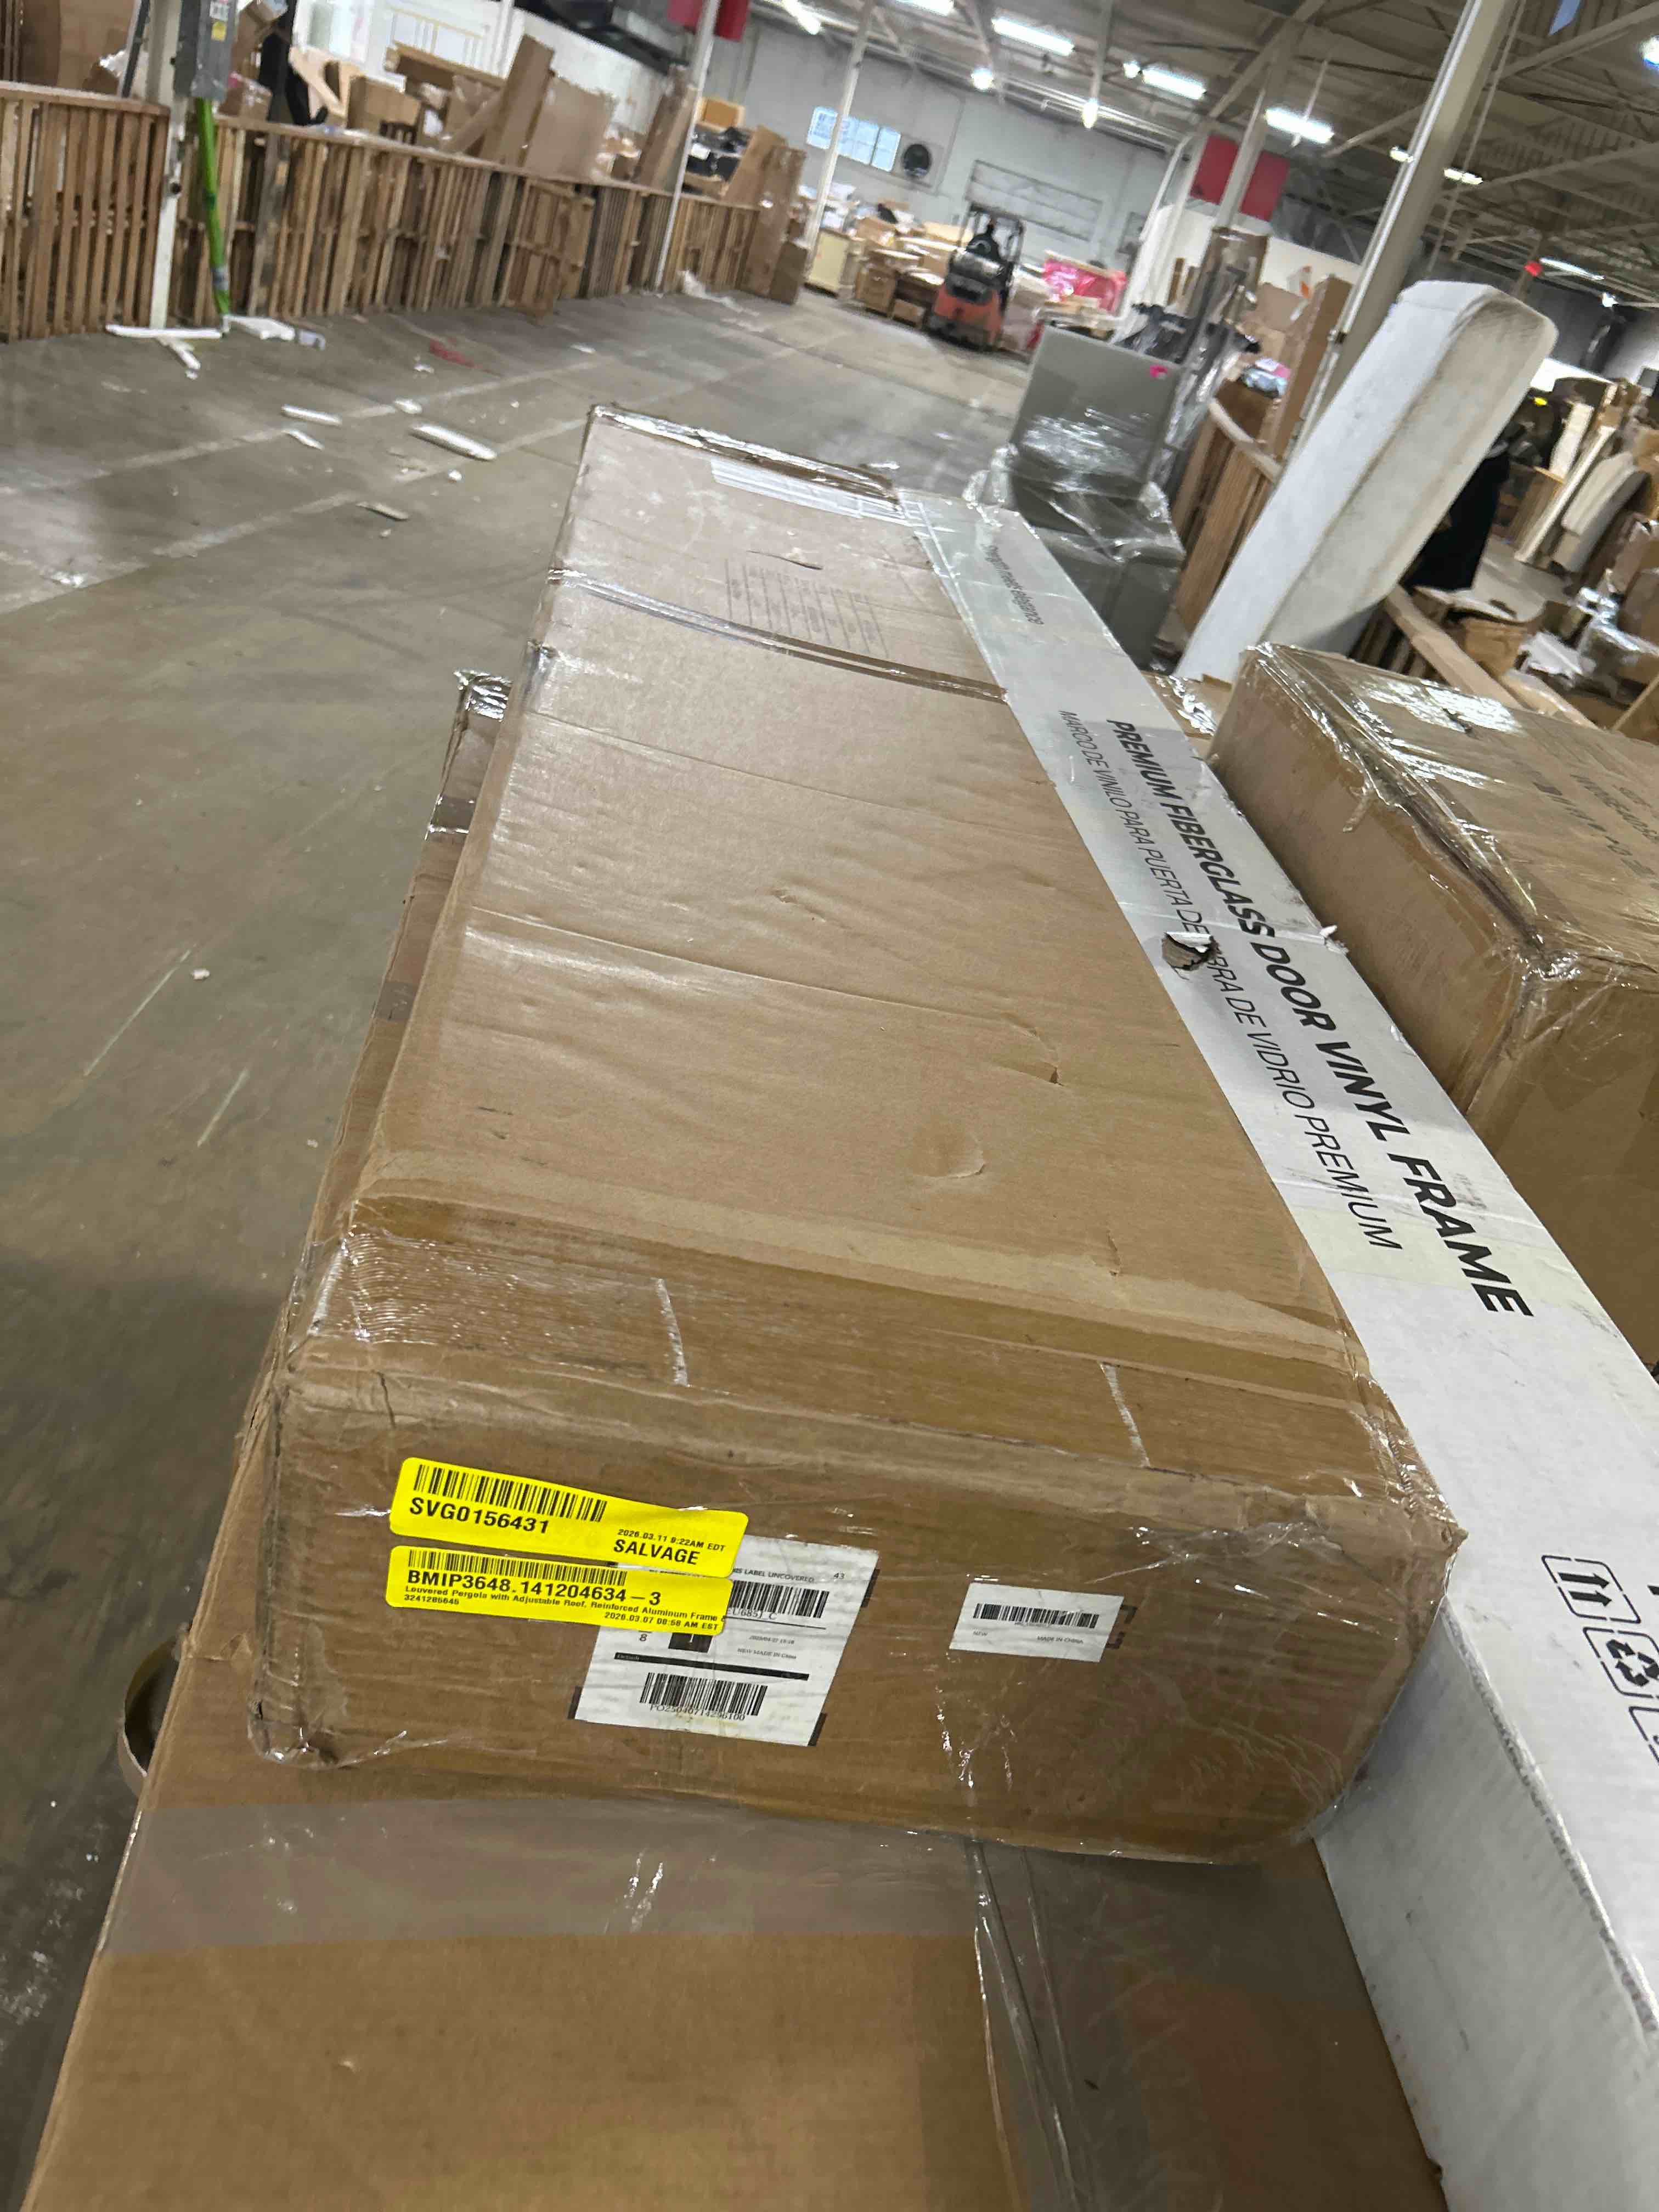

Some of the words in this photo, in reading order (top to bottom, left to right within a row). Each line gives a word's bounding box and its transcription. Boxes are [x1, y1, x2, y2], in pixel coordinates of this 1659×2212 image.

[1058, 710, 1098, 749] MARCO
[1081, 750, 1109, 769] DE
[1093, 770, 1132, 808] VINILO
[1115, 809, 1155, 844] PARA
[1138, 847, 1193, 905] PUERTA
[1176, 909, 1210, 934] DE
[1106, 719, 1184, 800] PREMIUM
[1160, 803, 1275, 938] FIBERGLASS
[1250, 942, 1335, 1031] DOOR
[1317, 1040, 1410, 1141] VINYL
[1389, 1152, 1534, 1317] FRAME
[1224, 997, 1267, 1028] DE
[1248, 1031, 1314, 1109] VIDRIO
[1294, 1116, 1402, 1249] PREMIUM
[410, 1497, 549, 1533] SVG0156431
[614, 1539, 701, 1565] SALVAGE
[617, 1528, 667, 1542] 2026.03.11
[707, 1543, 726, 1551] EDT
[405, 1585, 448, 1595] Louvered
[452, 1590, 487, 1599] Pergola
[491, 1593, 510, 1601] with
[513, 1595, 560, 1604] Adjustable
[590, 1601, 639, 1612] Reinforced
[642, 1607, 687, 1618] Aluminum
[691, 1612, 720, 1622] Frame
[408, 1570, 626, 1601] BMIP3648.141204634
[649, 1592, 661, 1605] 3
[639, 1633, 647, 1642] 8
